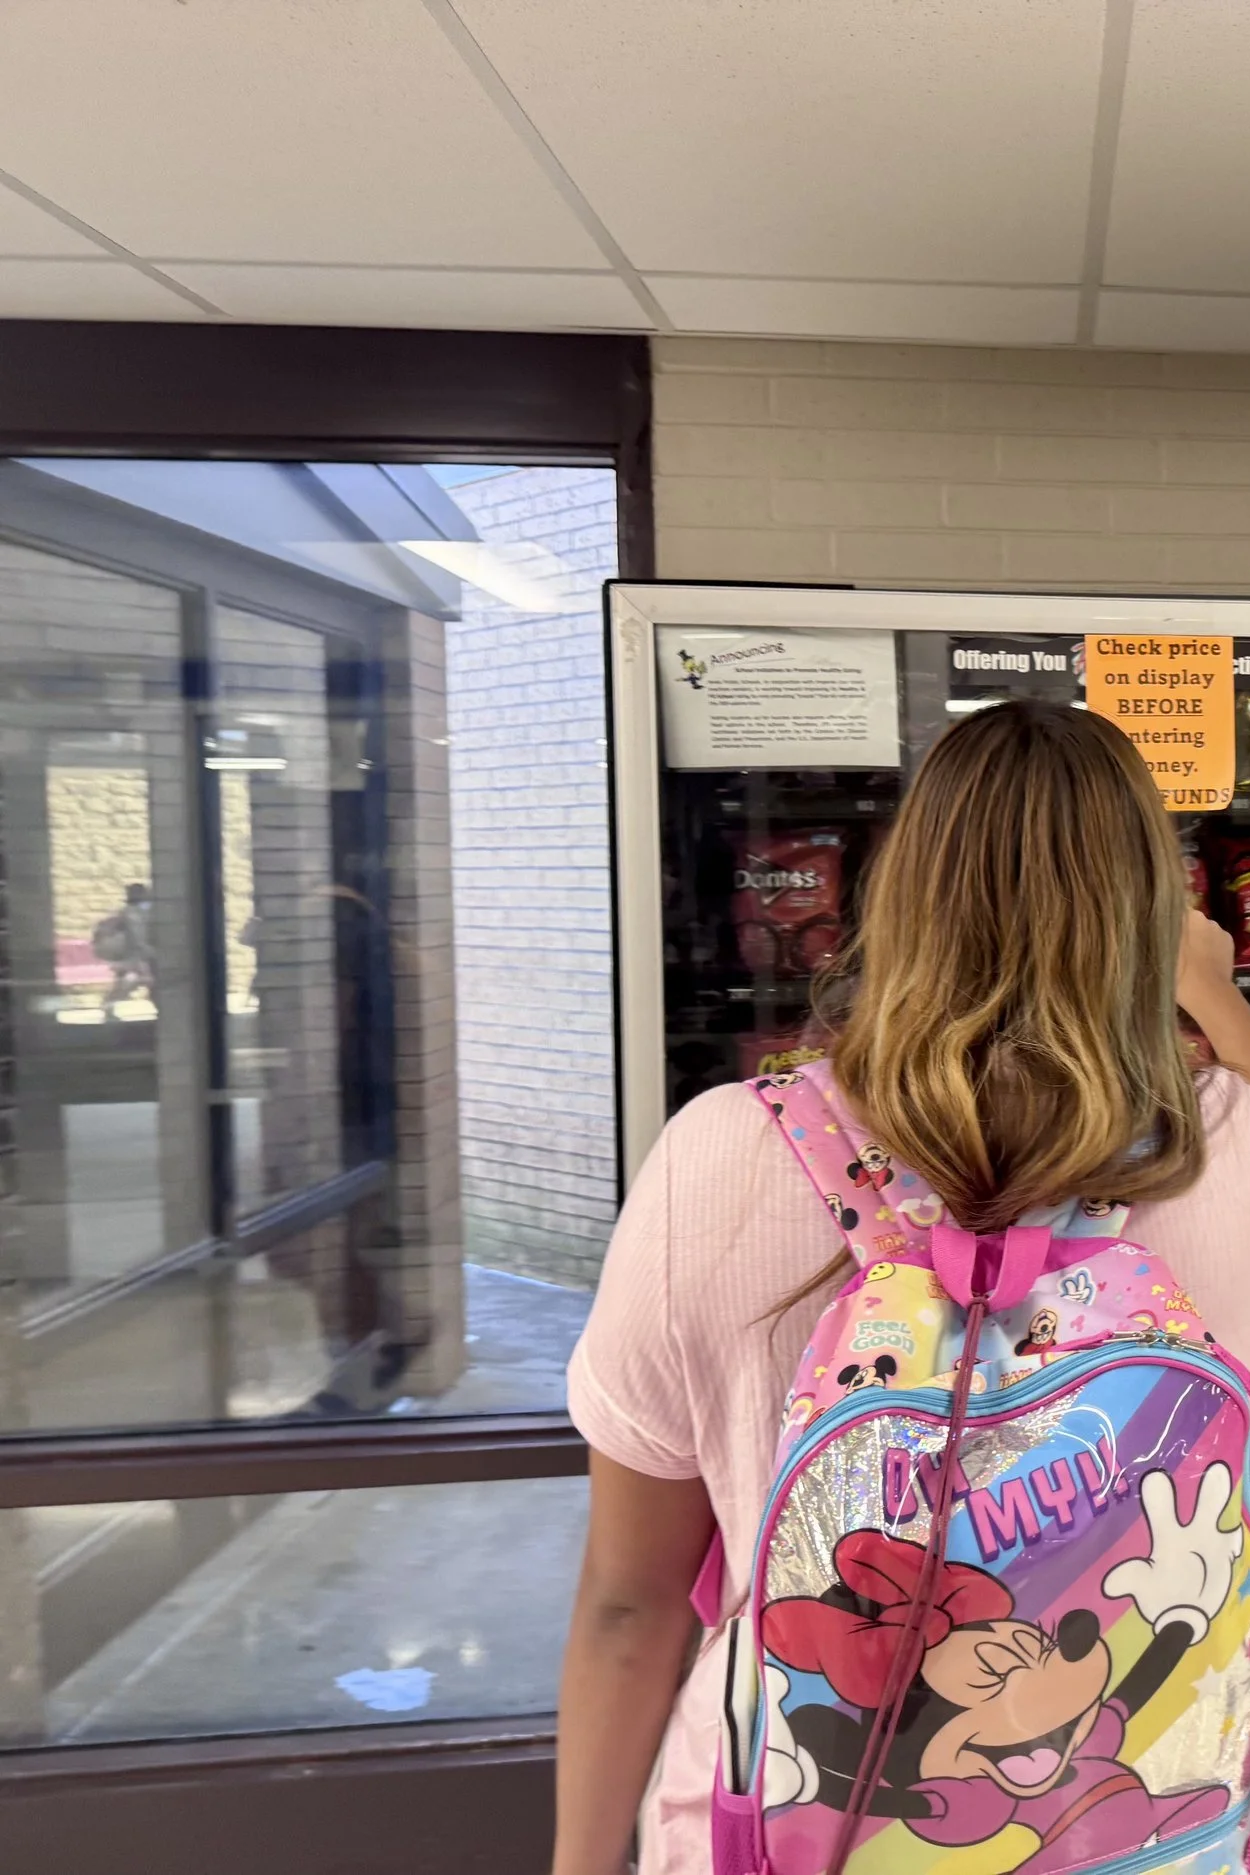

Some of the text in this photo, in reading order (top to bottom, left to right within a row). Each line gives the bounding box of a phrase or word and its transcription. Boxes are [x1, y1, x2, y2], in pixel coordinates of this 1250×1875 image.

[711, 642, 786, 664] Announcing
[1097, 639, 1221, 659] Check price
[953, 649, 1030, 673] Offering
[1032, 651, 1067, 671] You
[1104, 669, 1215, 689] on display
[1117, 699, 1203, 714] BEFORE
[1129, 728, 1205, 748] ntering
[1145, 761, 1198, 777] oney.
[1160, 787, 1230, 805] FUNDS
[851, 1334, 916, 1356] GOOD
